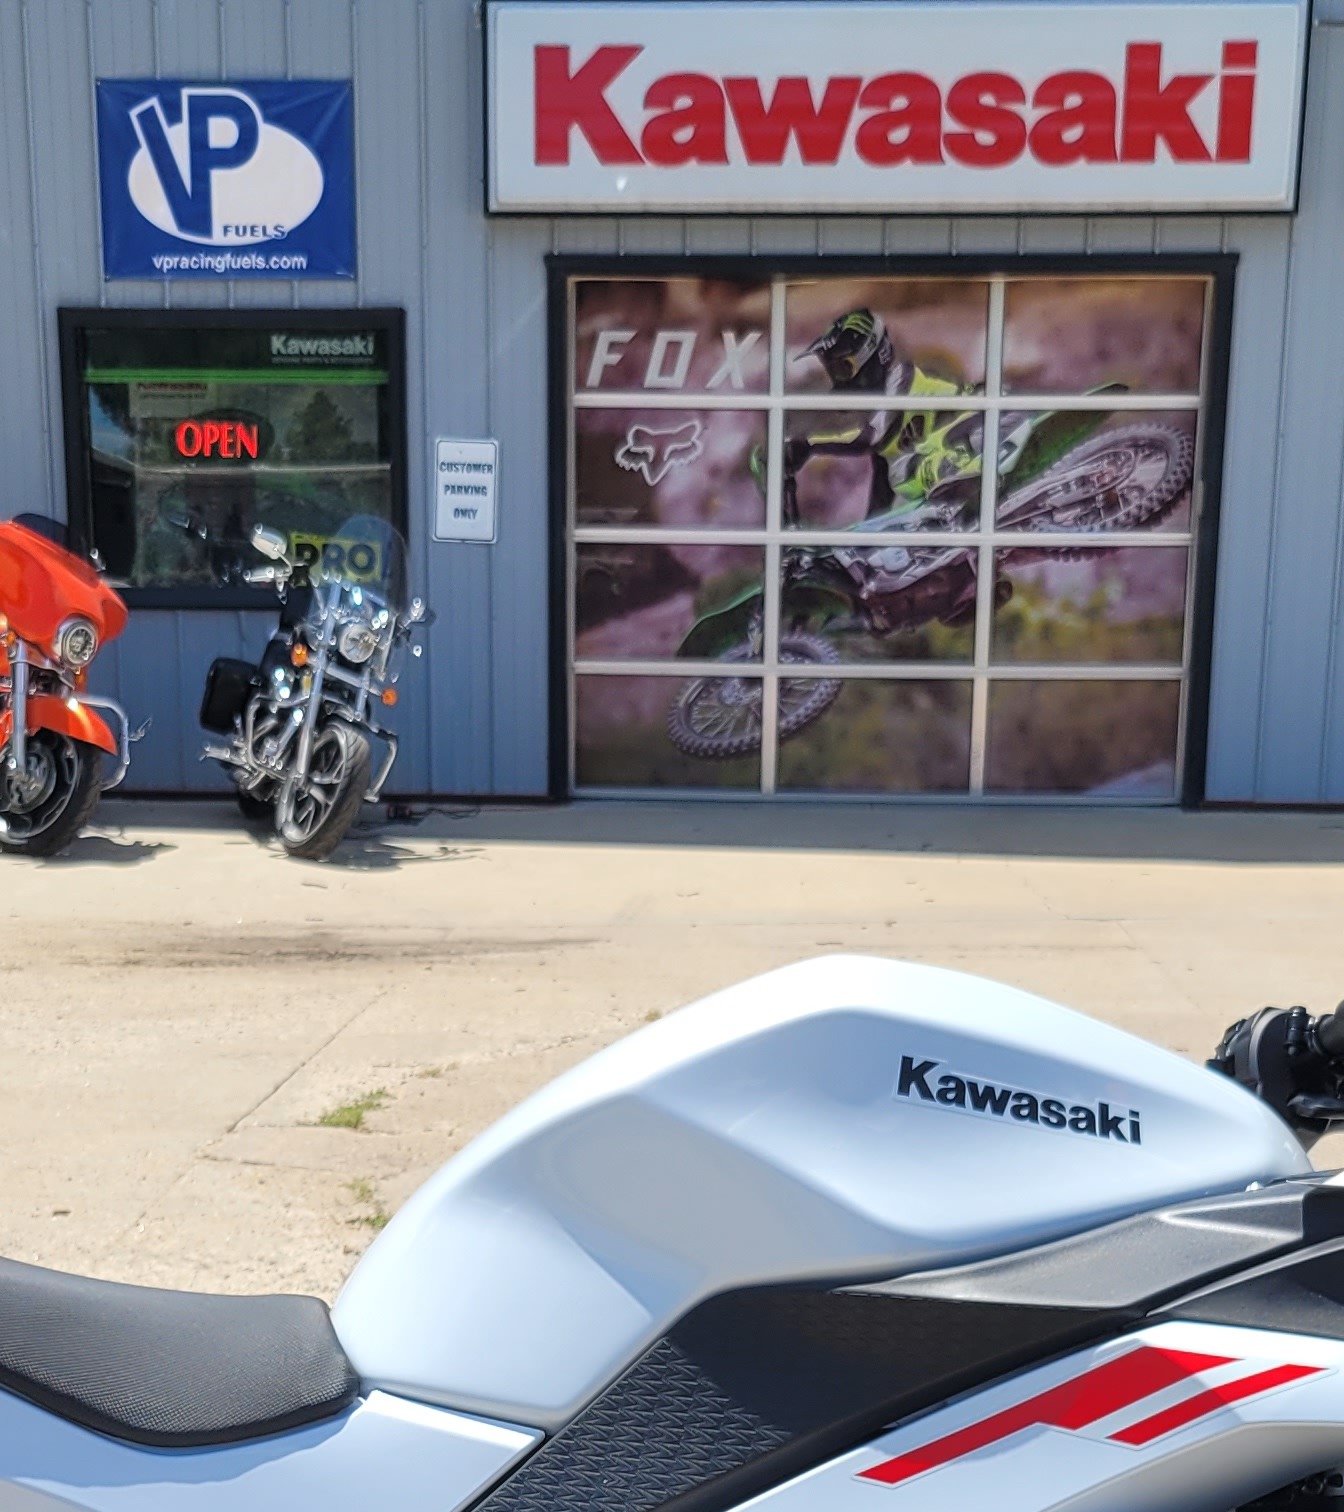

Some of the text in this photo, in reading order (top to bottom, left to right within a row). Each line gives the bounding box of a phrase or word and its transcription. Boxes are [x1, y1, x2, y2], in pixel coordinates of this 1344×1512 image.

[532, 40, 1258, 168] Kawasaki
[128, 87, 263, 241] VP
[223, 225, 288, 239] FUELS
[153, 253, 308, 273] vpracingfuels.com
[269, 334, 375, 356] Kawasaki
[585, 330, 763, 389] FOX
[175, 420, 259, 459] OPEN
[439, 461, 494, 474] CUSTOMER
[444, 484, 488, 497] PARKING
[453, 507, 478, 519] ONLY
[895, 1055, 1142, 1146] Kawasaki
